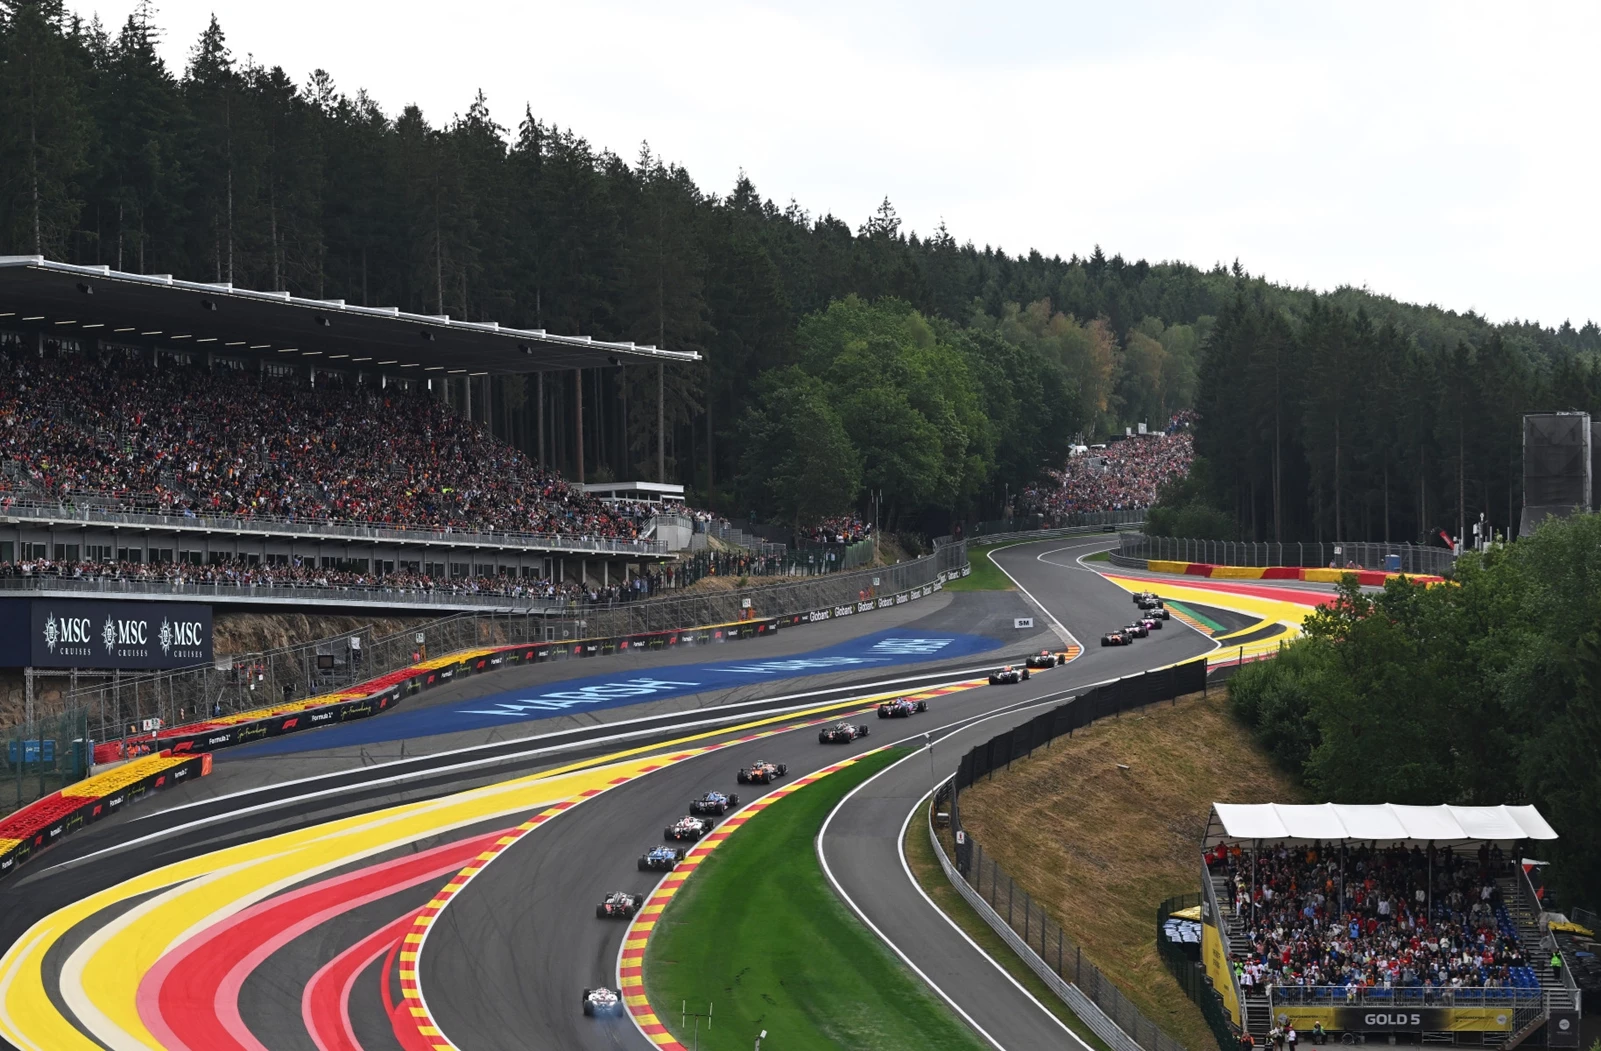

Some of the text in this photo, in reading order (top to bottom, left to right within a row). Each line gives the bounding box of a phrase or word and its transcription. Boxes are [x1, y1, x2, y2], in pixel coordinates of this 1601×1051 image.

[834, 606, 853, 617] Globant
[857, 602, 874, 612] Globant
[809, 610, 829, 622] Globant
[60, 618, 91, 643] MSC
[117, 620, 148, 645] MSC
[173, 621, 202, 646] MSC
[60, 647, 91, 656] CRUISES
[118, 649, 148, 657] CRUISES
[173, 650, 203, 658] CRUISES
[453, 679, 701, 716] MARSH
[311, 713, 328, 722] Formula
[209, 735, 226, 745] Formula
[1365, 1014, 1421, 1025] GOLD 5
